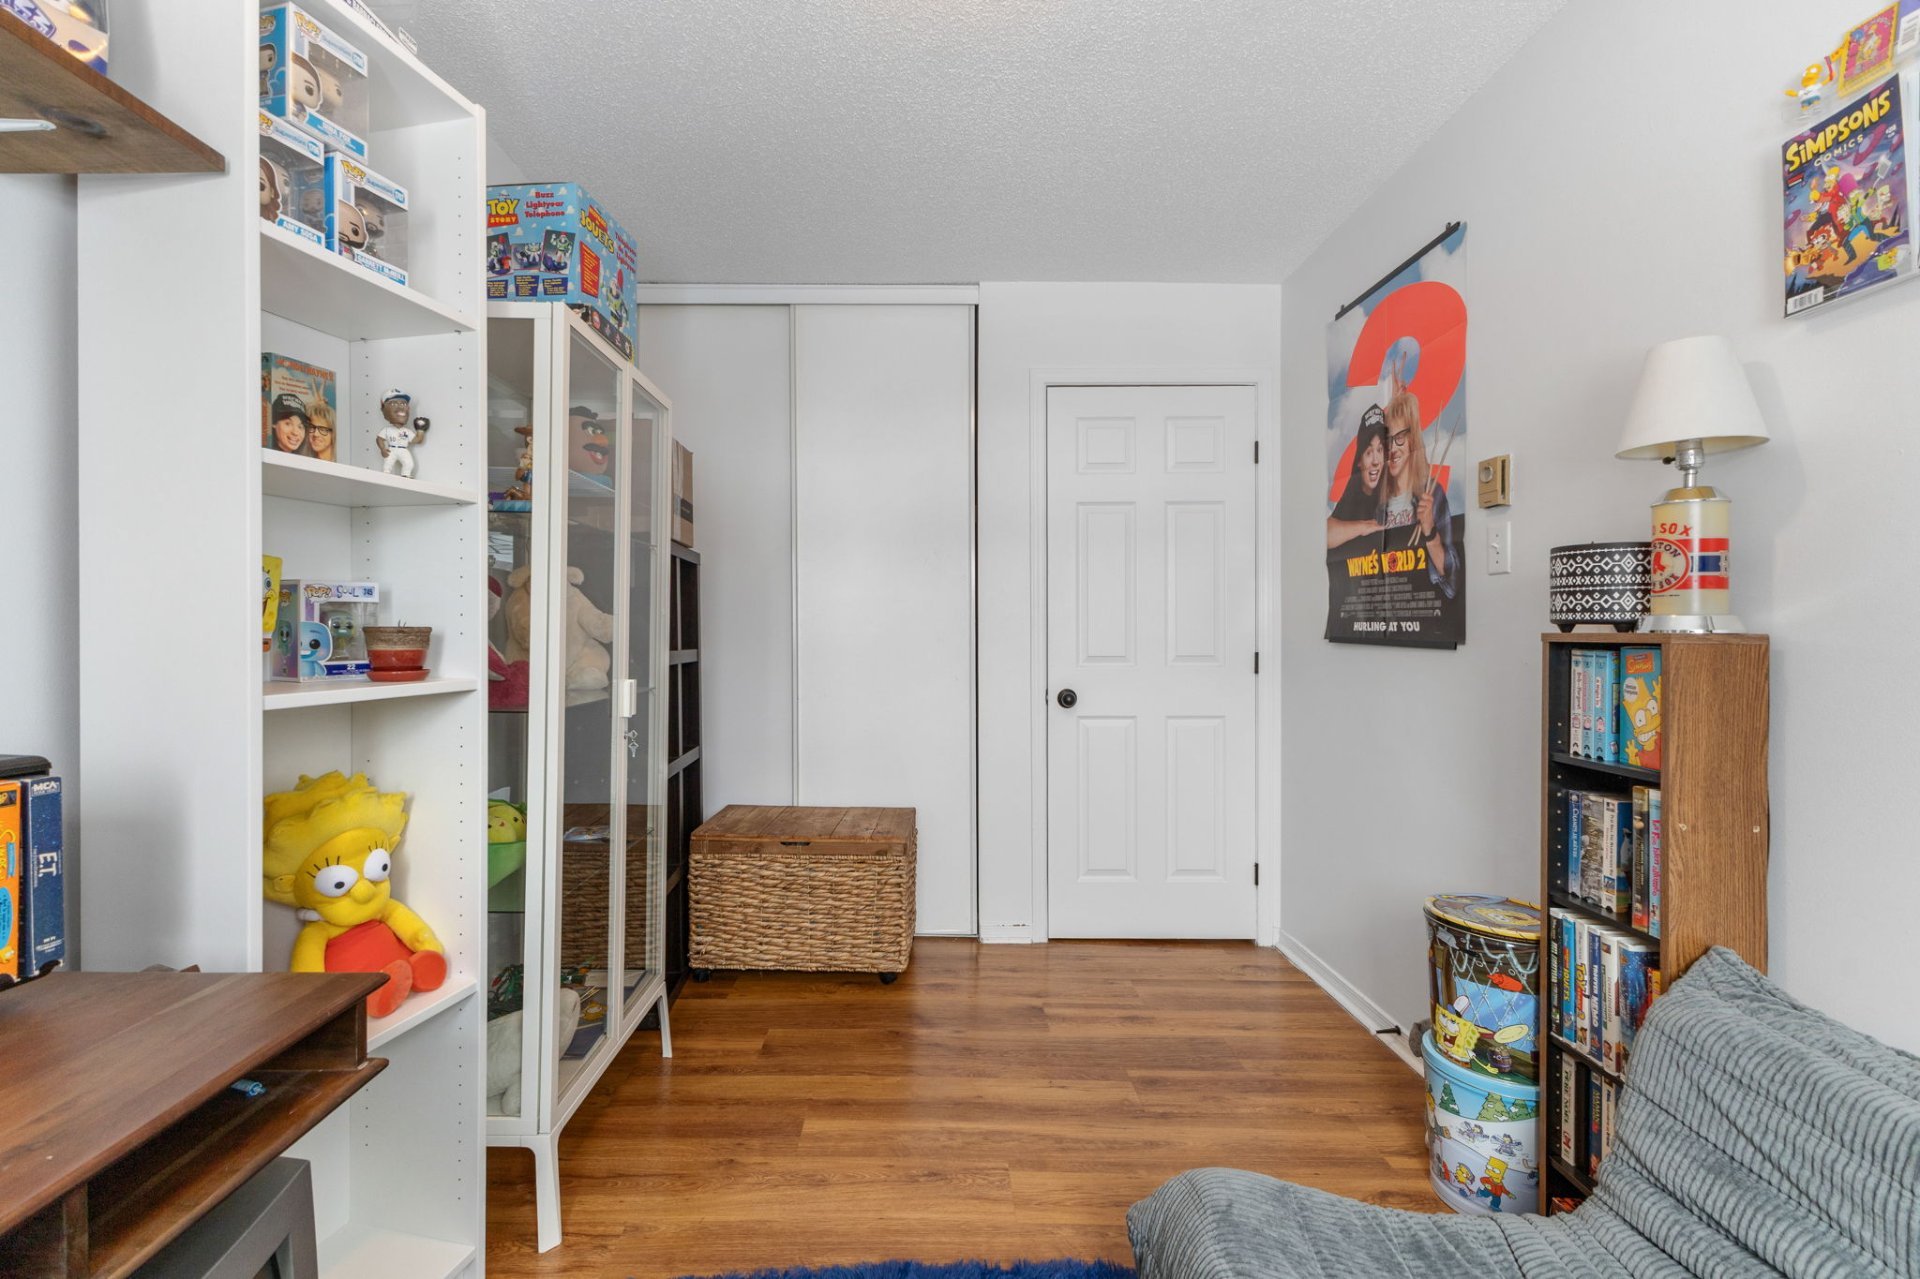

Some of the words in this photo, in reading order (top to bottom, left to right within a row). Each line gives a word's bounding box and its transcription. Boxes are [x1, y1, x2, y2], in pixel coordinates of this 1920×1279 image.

[1786, 90, 1891, 172] SIMPSONS
[1814, 134, 1864, 167] COMICS
[487, 198, 520, 215] TOY
[526, 201, 564, 209] Lightyear
[490, 216, 517, 224] STORY
[524, 210, 566, 219] Telephone
[580, 208, 615, 254] JOUETS
[1659, 522, 1692, 537] SOX
[1652, 541, 1681, 558] STON
[1346, 549, 1379, 577] WAYNE'S
[1381, 550, 1415, 575] WORLD
[1417, 548, 1426, 570] 2
[304, 584, 331, 599] POP!
[1353, 621, 1387, 632] HURLING
[1388, 621, 1398, 632] AT
[1400, 621, 1420, 632] YOU
[32, 781, 57, 792] MCA
[38, 852, 58, 878] E.T.
[1576, 963, 1587, 988] TOY
[1577, 1010, 1585, 1020] 2
[1591, 994, 1599, 1027] NEMO
